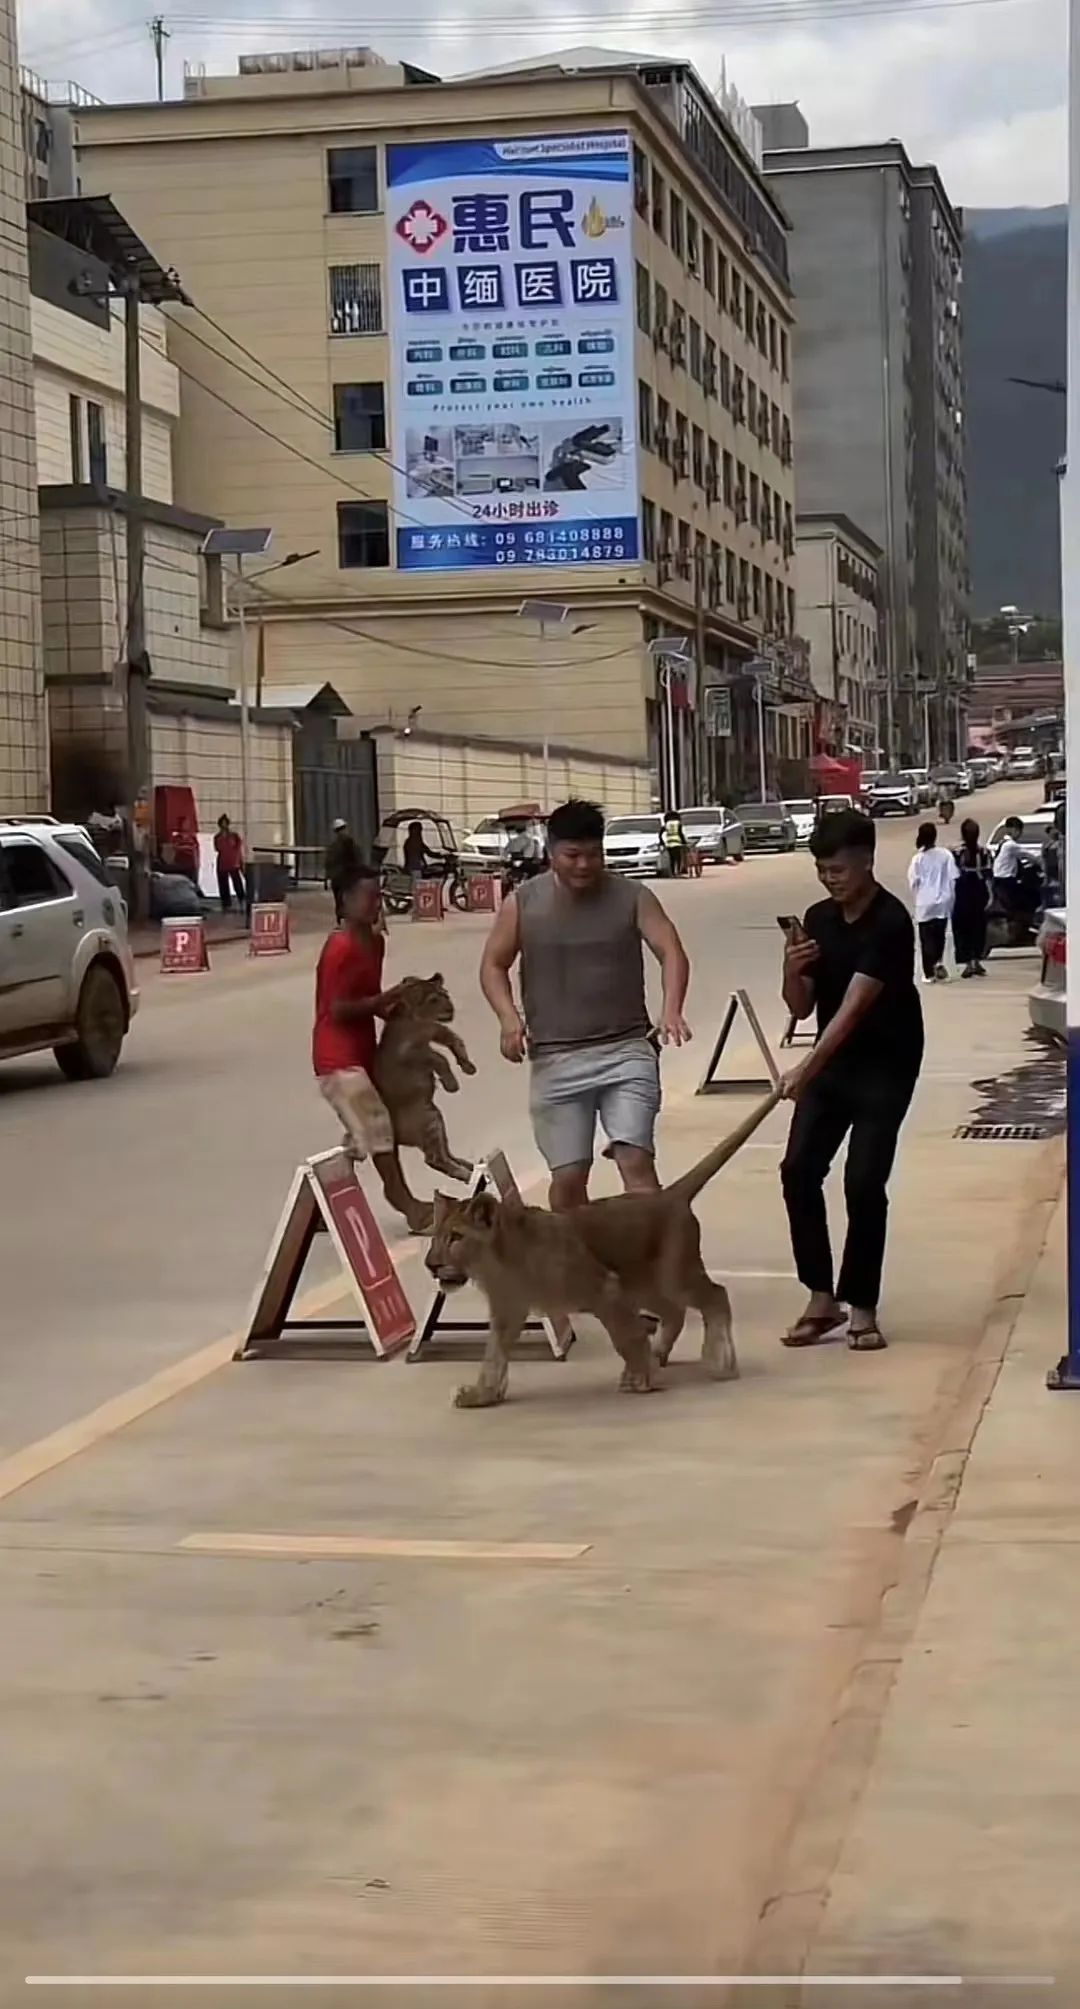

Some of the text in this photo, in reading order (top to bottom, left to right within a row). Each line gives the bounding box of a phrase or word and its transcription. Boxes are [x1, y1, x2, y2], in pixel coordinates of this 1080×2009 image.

[451, 188, 577, 254] 惠民
[408, 262, 612, 308] 中缅医院
[472, 500, 560, 519] 24小时出诊
[495, 532, 516, 545] 09
[495, 549, 516, 563] 09
[175, 931, 190, 953] P
[344, 1206, 377, 1279] P
